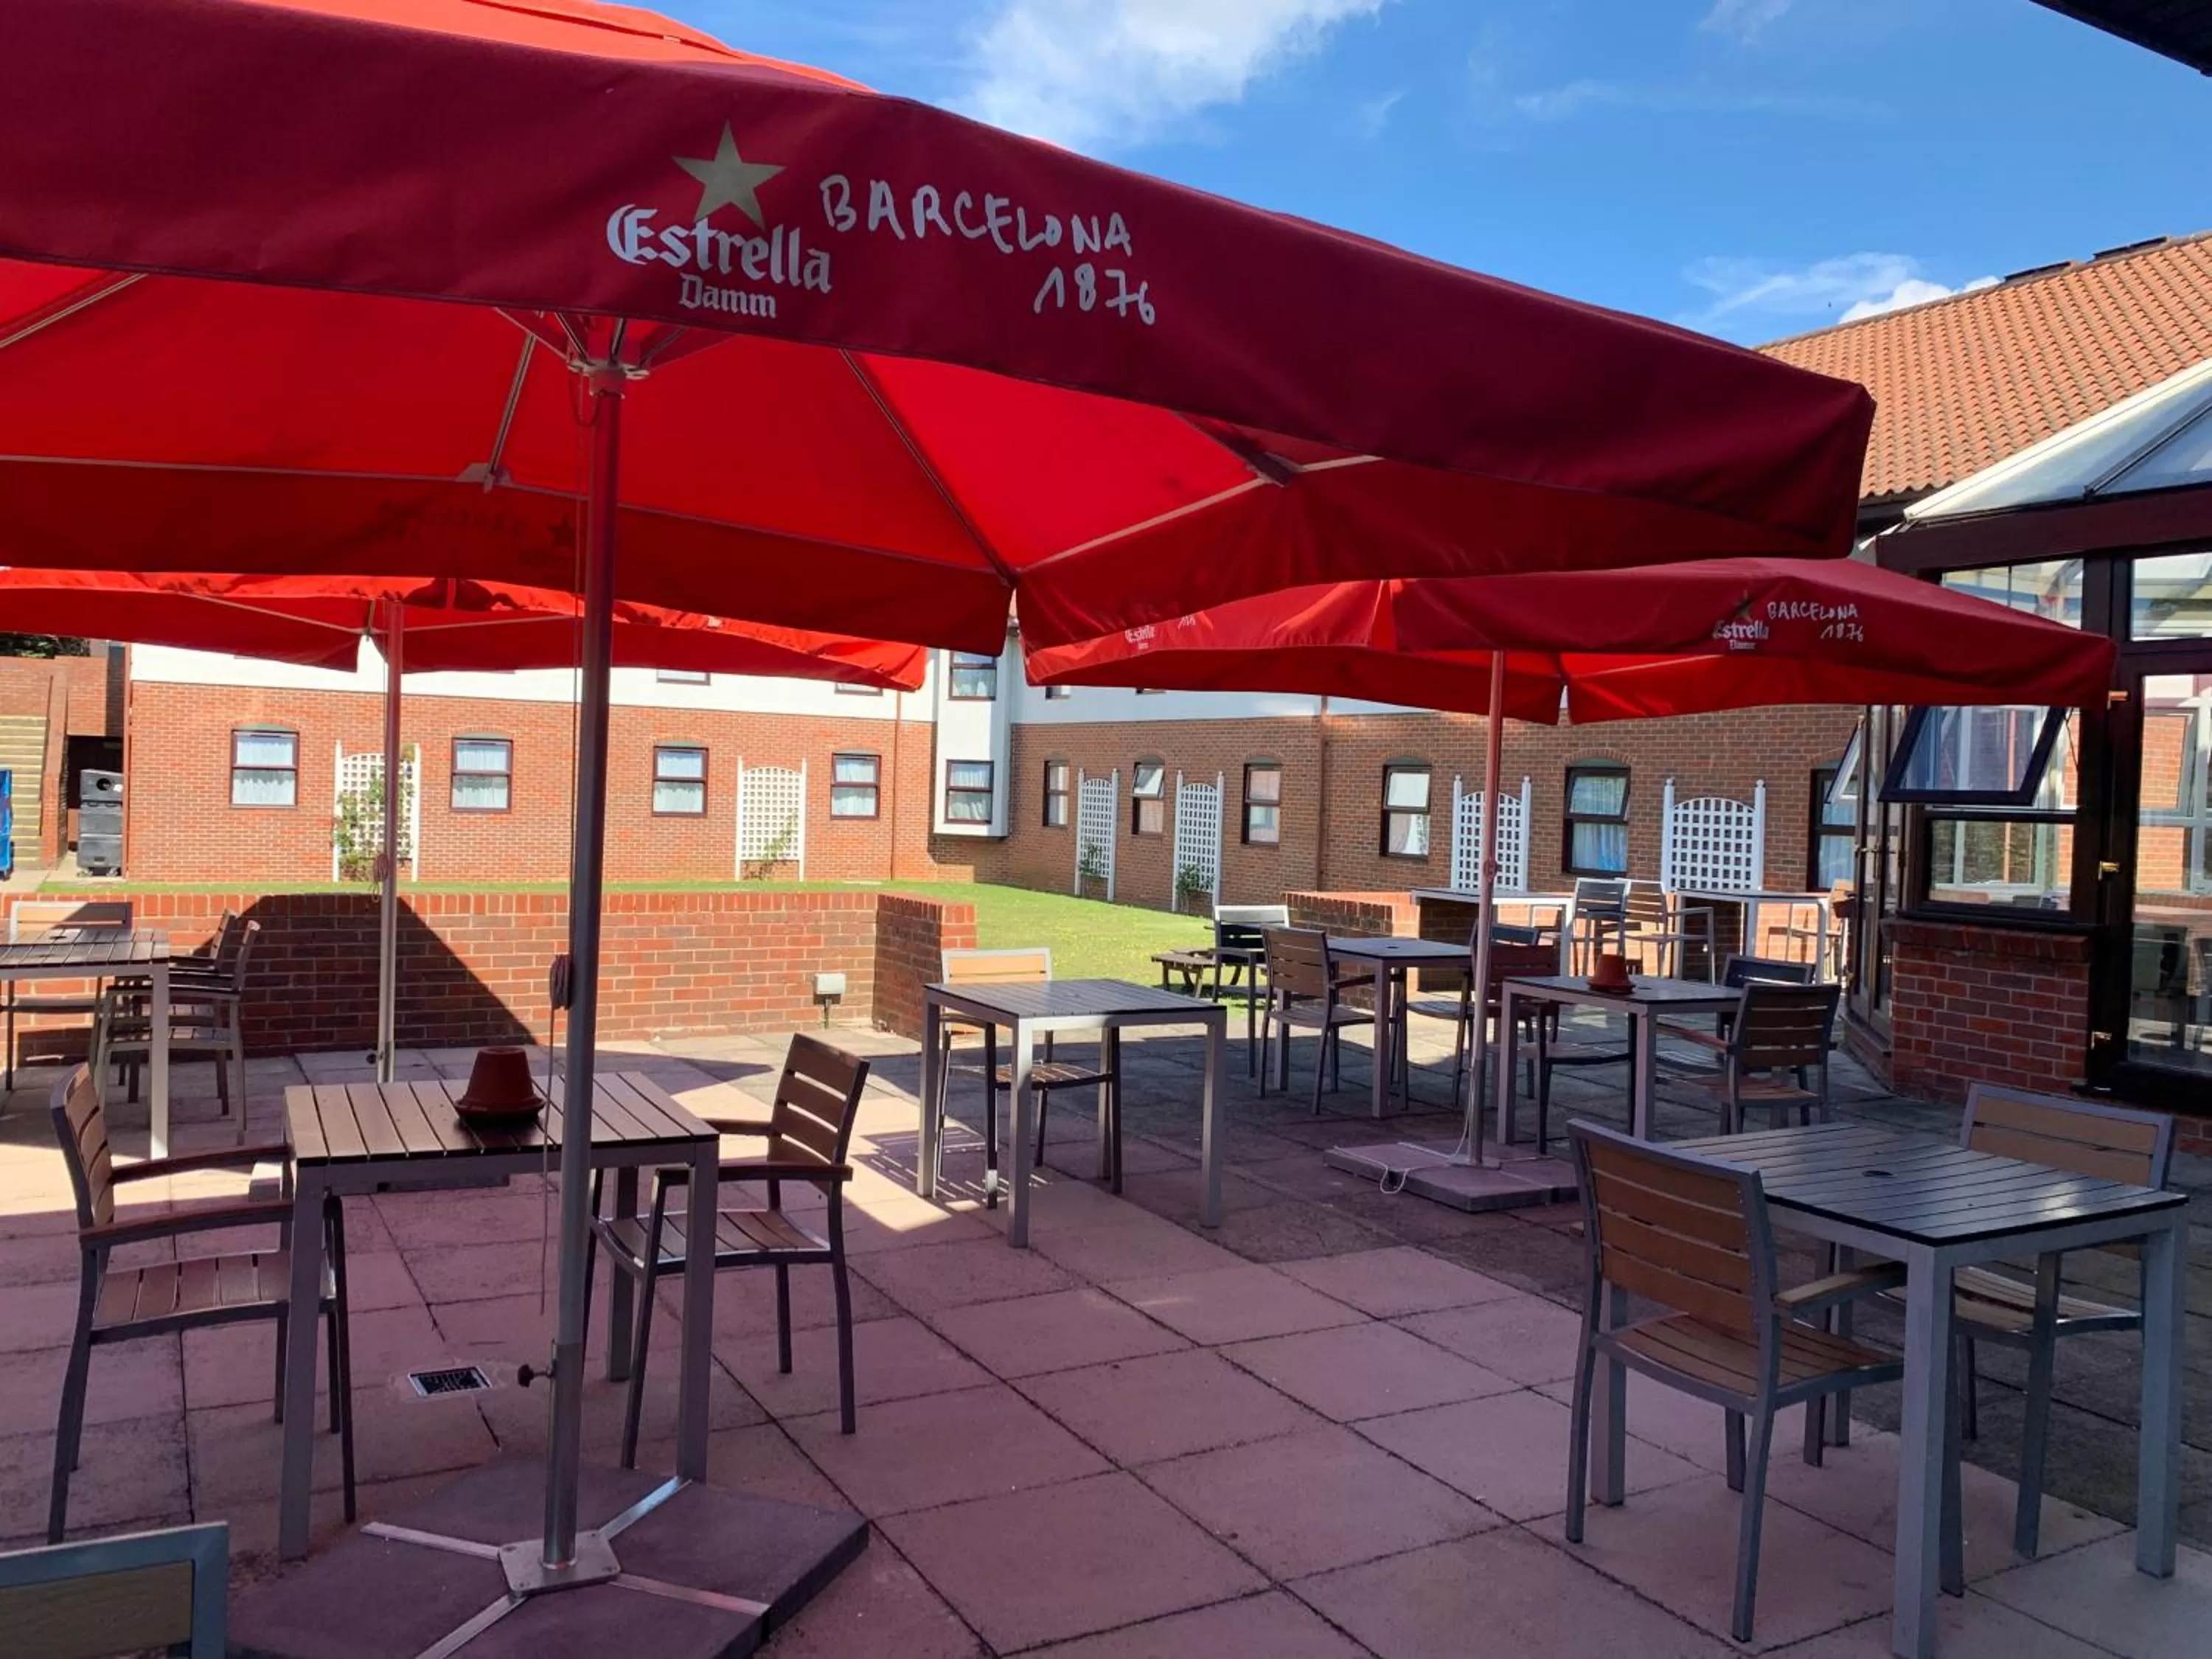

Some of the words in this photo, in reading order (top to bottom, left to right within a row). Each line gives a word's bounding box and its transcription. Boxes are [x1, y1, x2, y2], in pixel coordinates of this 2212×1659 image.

[819, 174, 1134, 256] BARCELONA
[607, 204, 833, 294] Estrella
[680, 272, 777, 319] Damm
[1034, 263, 1156, 325] 1876
[1712, 619, 1769, 639] Estrella
[1767, 601, 1858, 620] BARCELONA
